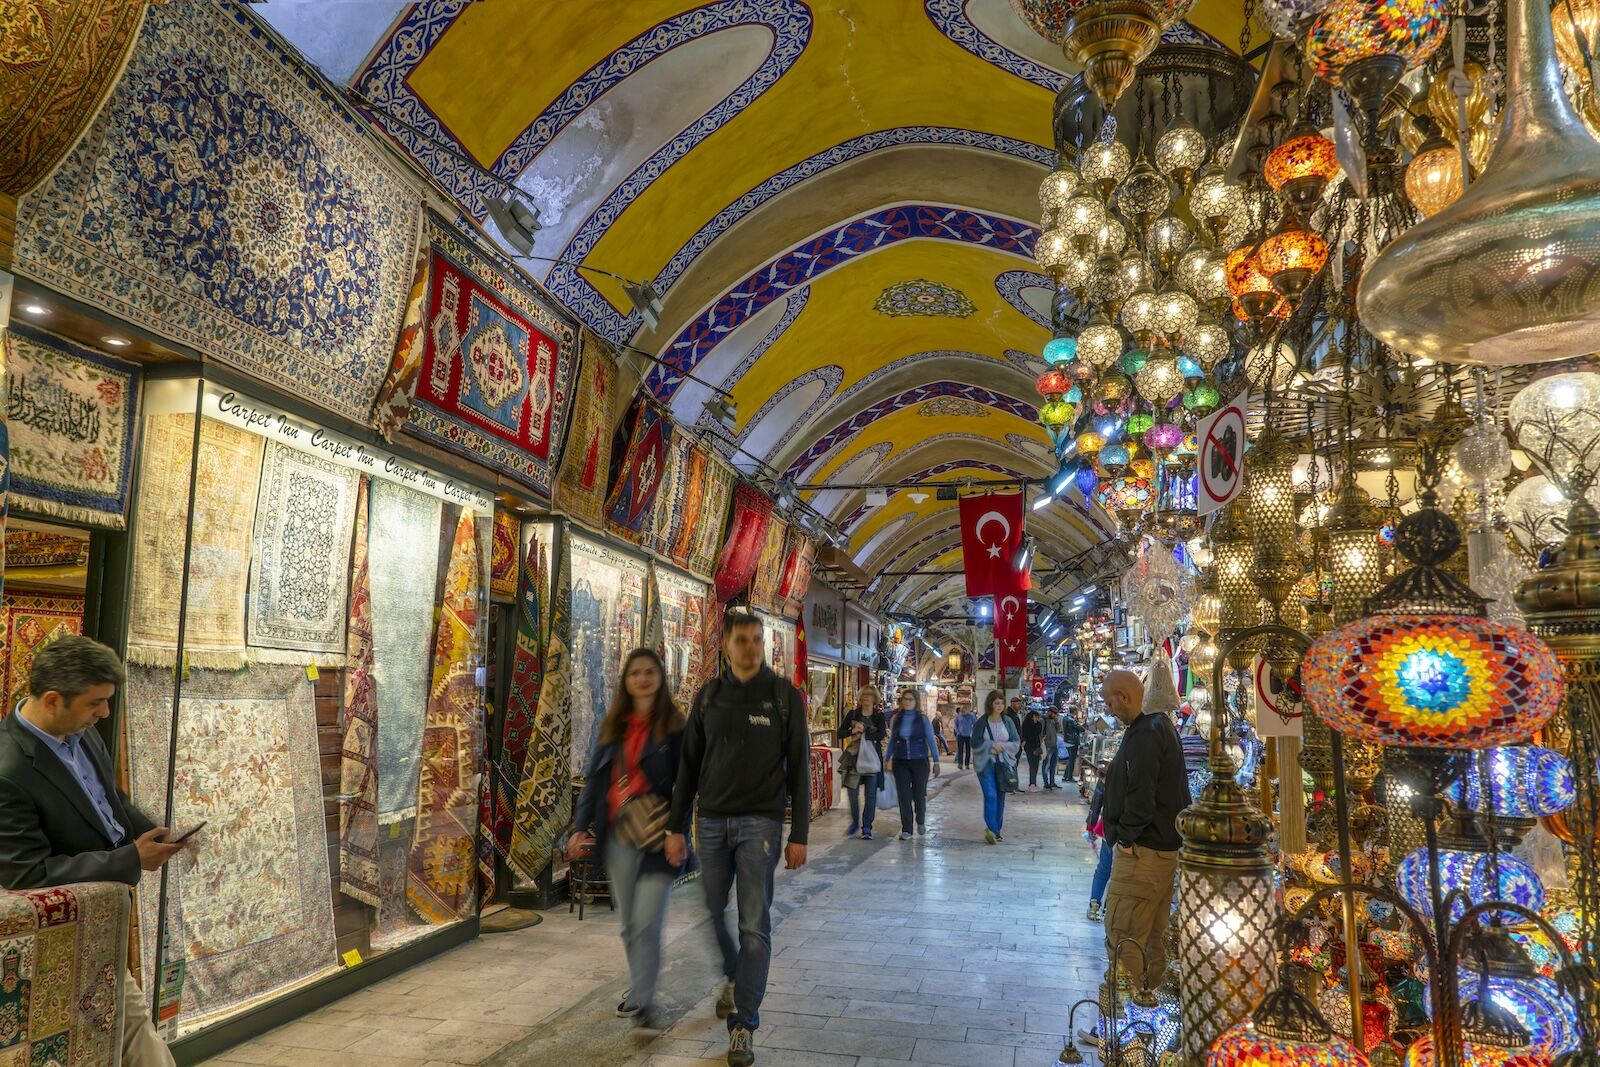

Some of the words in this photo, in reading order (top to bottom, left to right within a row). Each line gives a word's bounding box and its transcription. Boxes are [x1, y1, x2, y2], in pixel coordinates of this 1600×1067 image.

[218, 392, 272, 427] Carpet
[277, 415, 299, 439] Inn
[311, 428, 352, 459] Carpet
[357, 445, 375, 467] Inn
[385, 456, 419, 483] Carpet
[421, 470, 436, 490] Inn
[444, 479, 473, 503] Carpet
[475, 491, 488, 508] Inn
[599, 548, 627, 567] Shipping
